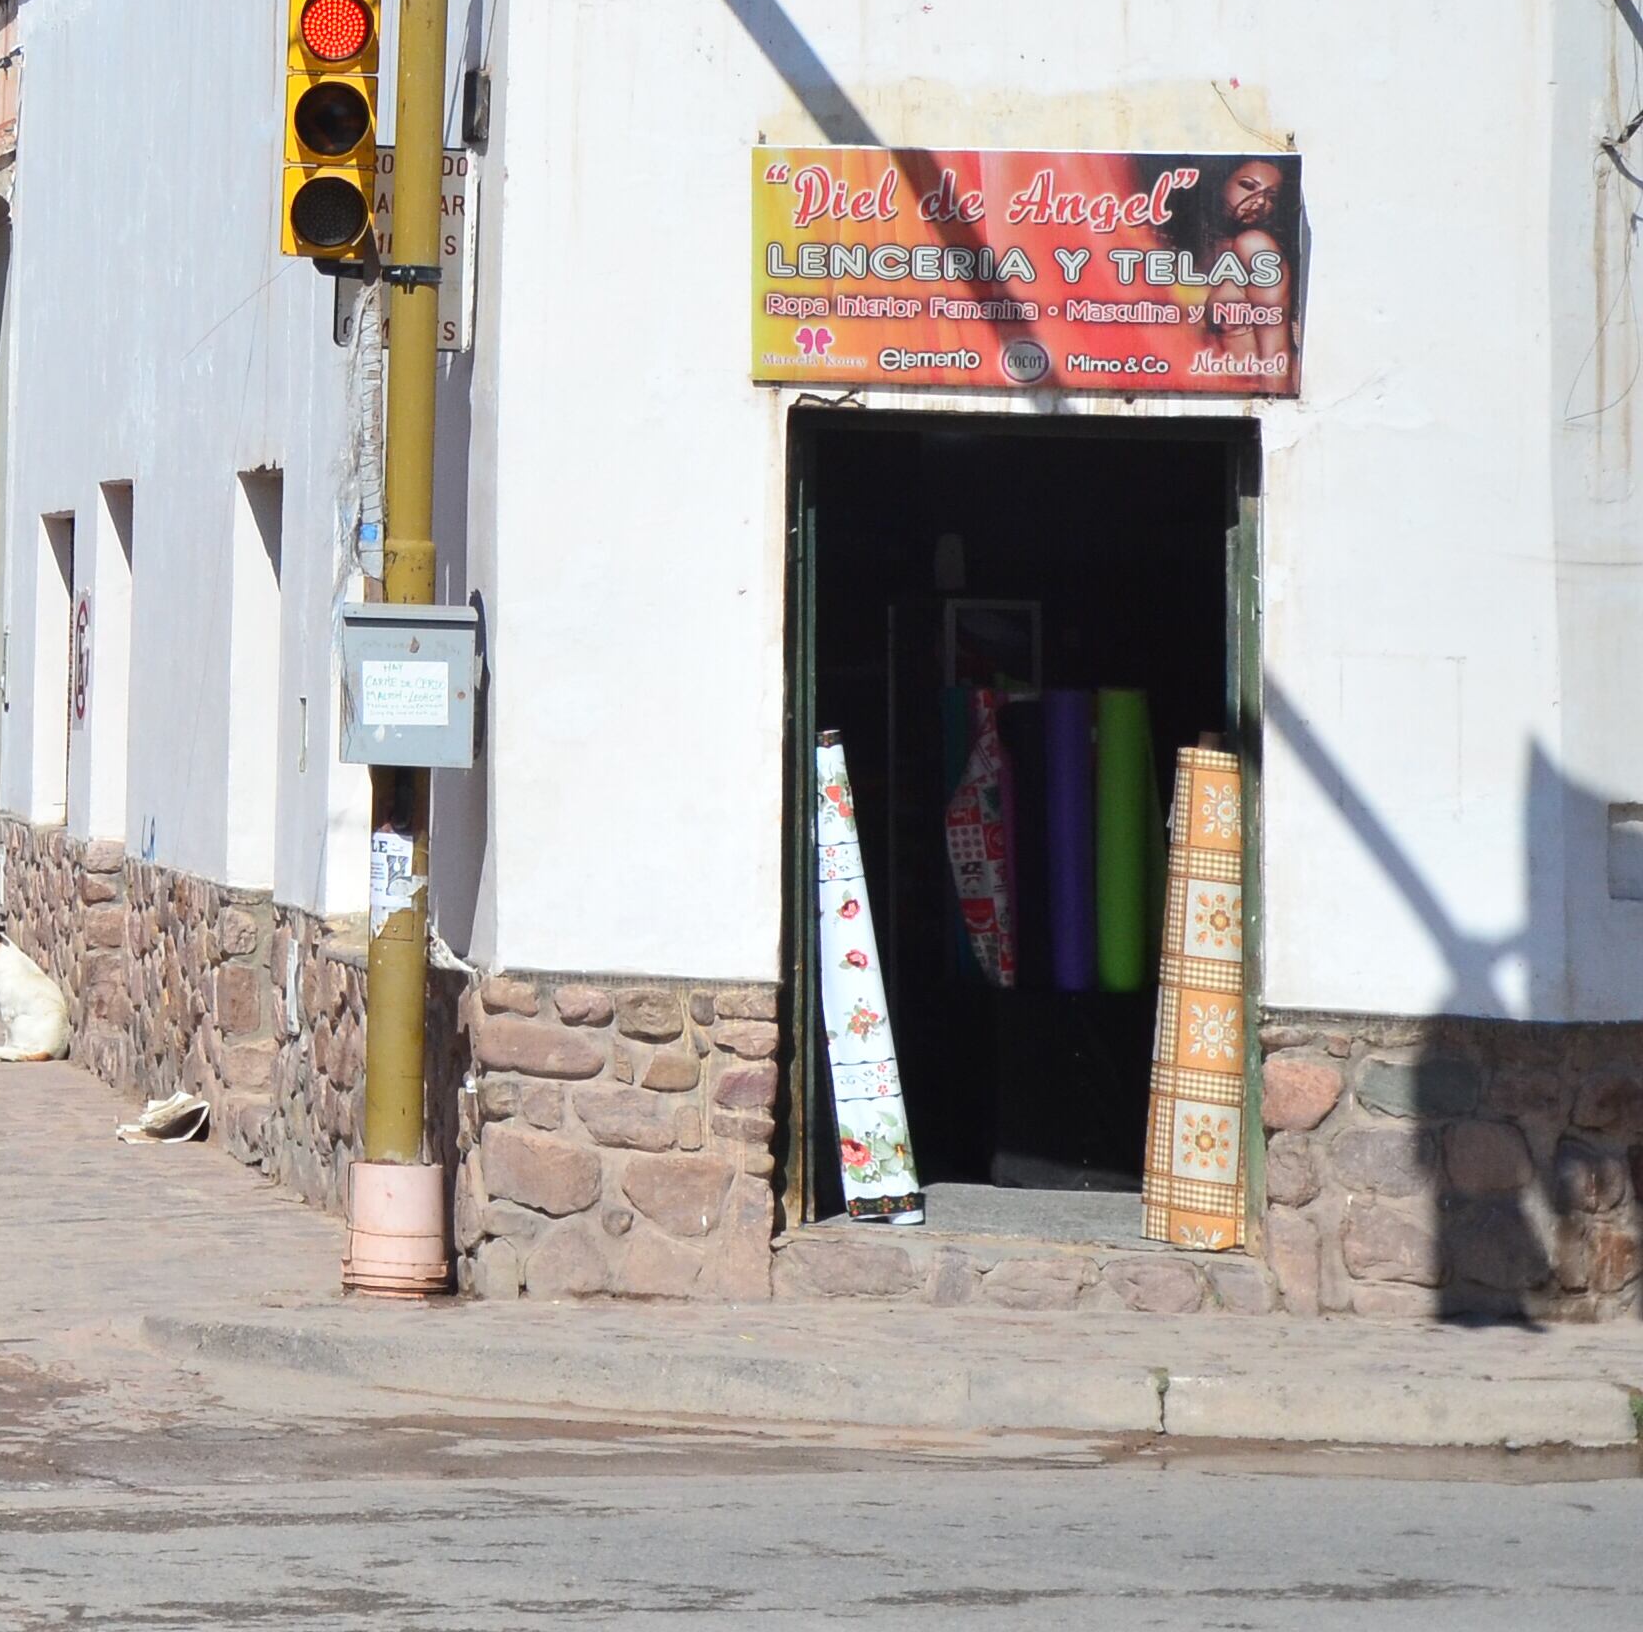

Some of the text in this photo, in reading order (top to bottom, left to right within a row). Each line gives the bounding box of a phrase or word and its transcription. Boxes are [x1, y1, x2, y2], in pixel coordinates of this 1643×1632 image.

[920, 168, 985, 223] de
[766, 242, 1283, 287] LENCERIA Y TELAS
[766, 293, 1283, 325] Ropa Interior Femenina Masculina y Niños
[1067, 354, 1122, 373] Mimo
[1141, 355, 1169, 374] Co
